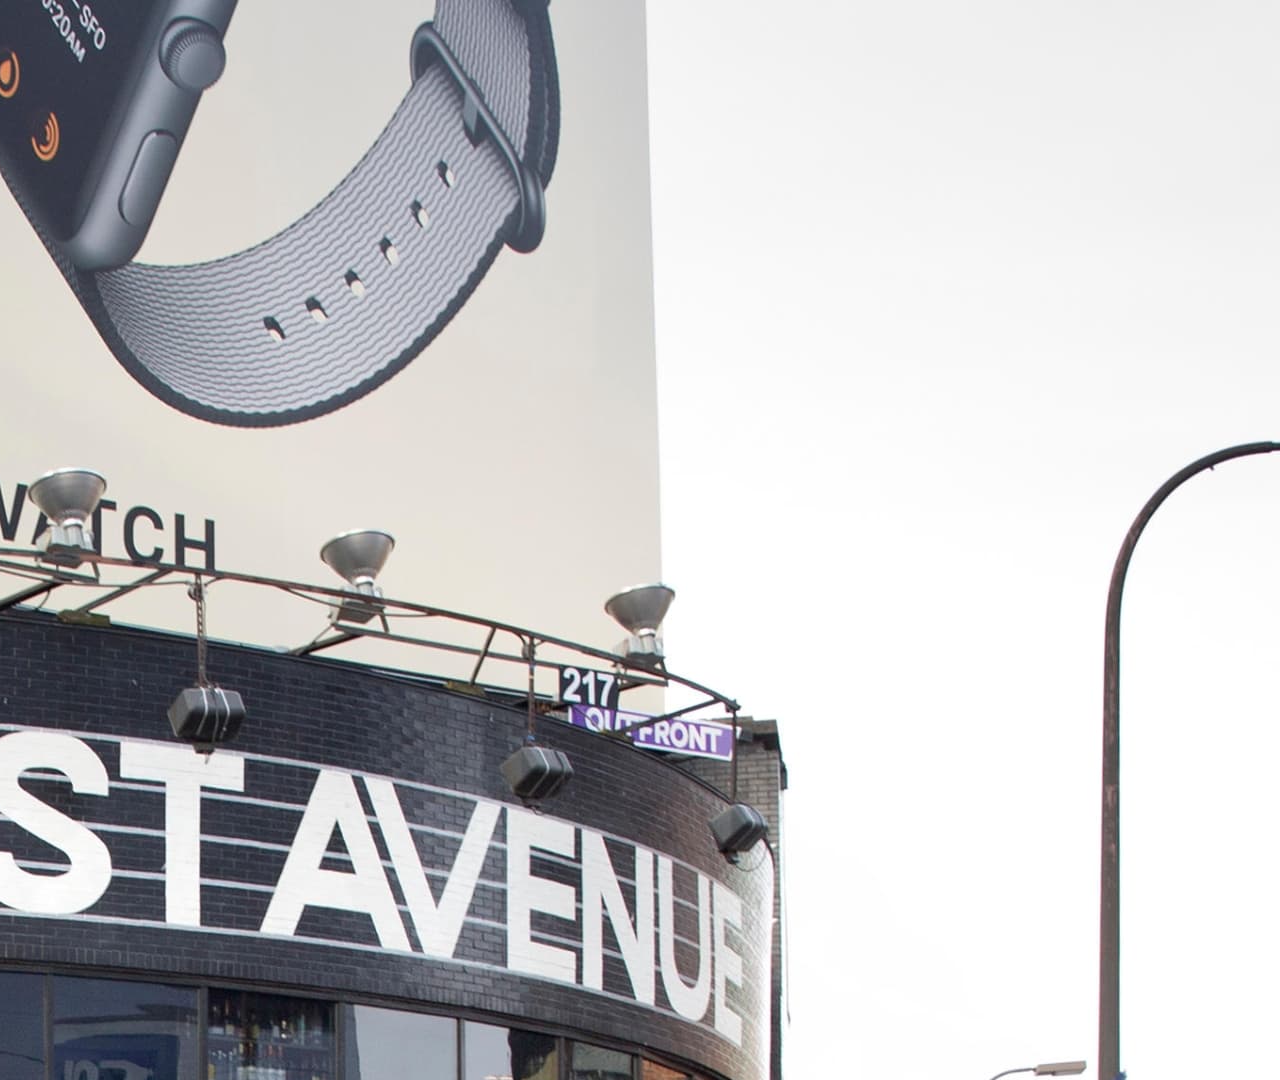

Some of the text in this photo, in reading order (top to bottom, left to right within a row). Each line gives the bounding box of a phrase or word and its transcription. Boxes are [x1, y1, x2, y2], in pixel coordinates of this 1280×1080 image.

[80, 4, 106, 50] SFO
[563, 667, 616, 708] 217
[257, 765, 743, 1049] AVENUE
